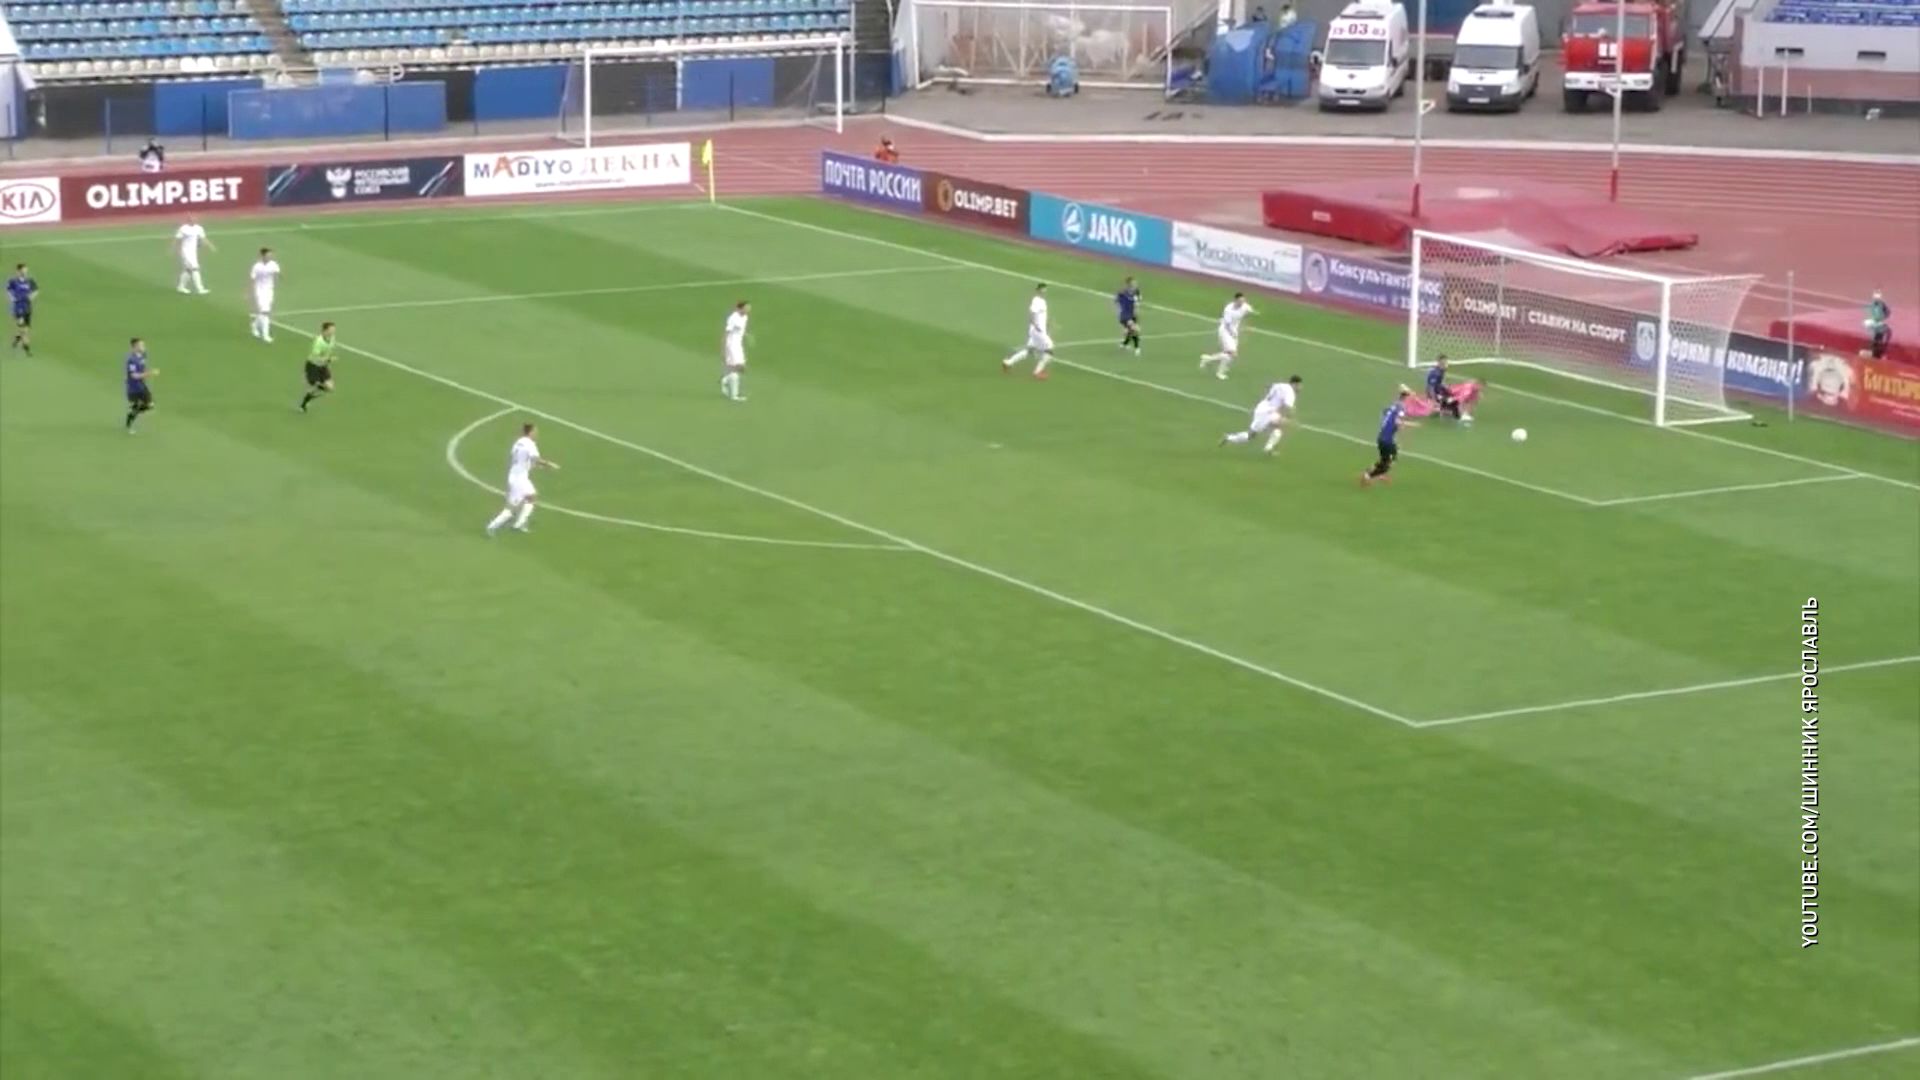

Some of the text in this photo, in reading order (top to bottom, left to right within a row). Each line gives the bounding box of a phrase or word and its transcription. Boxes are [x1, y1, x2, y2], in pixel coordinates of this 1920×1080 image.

[1348, 23, 1369, 35] 03
[86, 177, 243, 208] OLIMP.BET
[825, 159, 922, 203] ПОЧТА РОССИИ
[2, 191, 44, 211] KIA
[954, 188, 1019, 219] OLIMP.BET
[1088, 213, 1138, 248] JAKO
[1528, 310, 1627, 343] СТАВКИ НА СПОРТ
[1664, 334, 1710, 364] ерим
